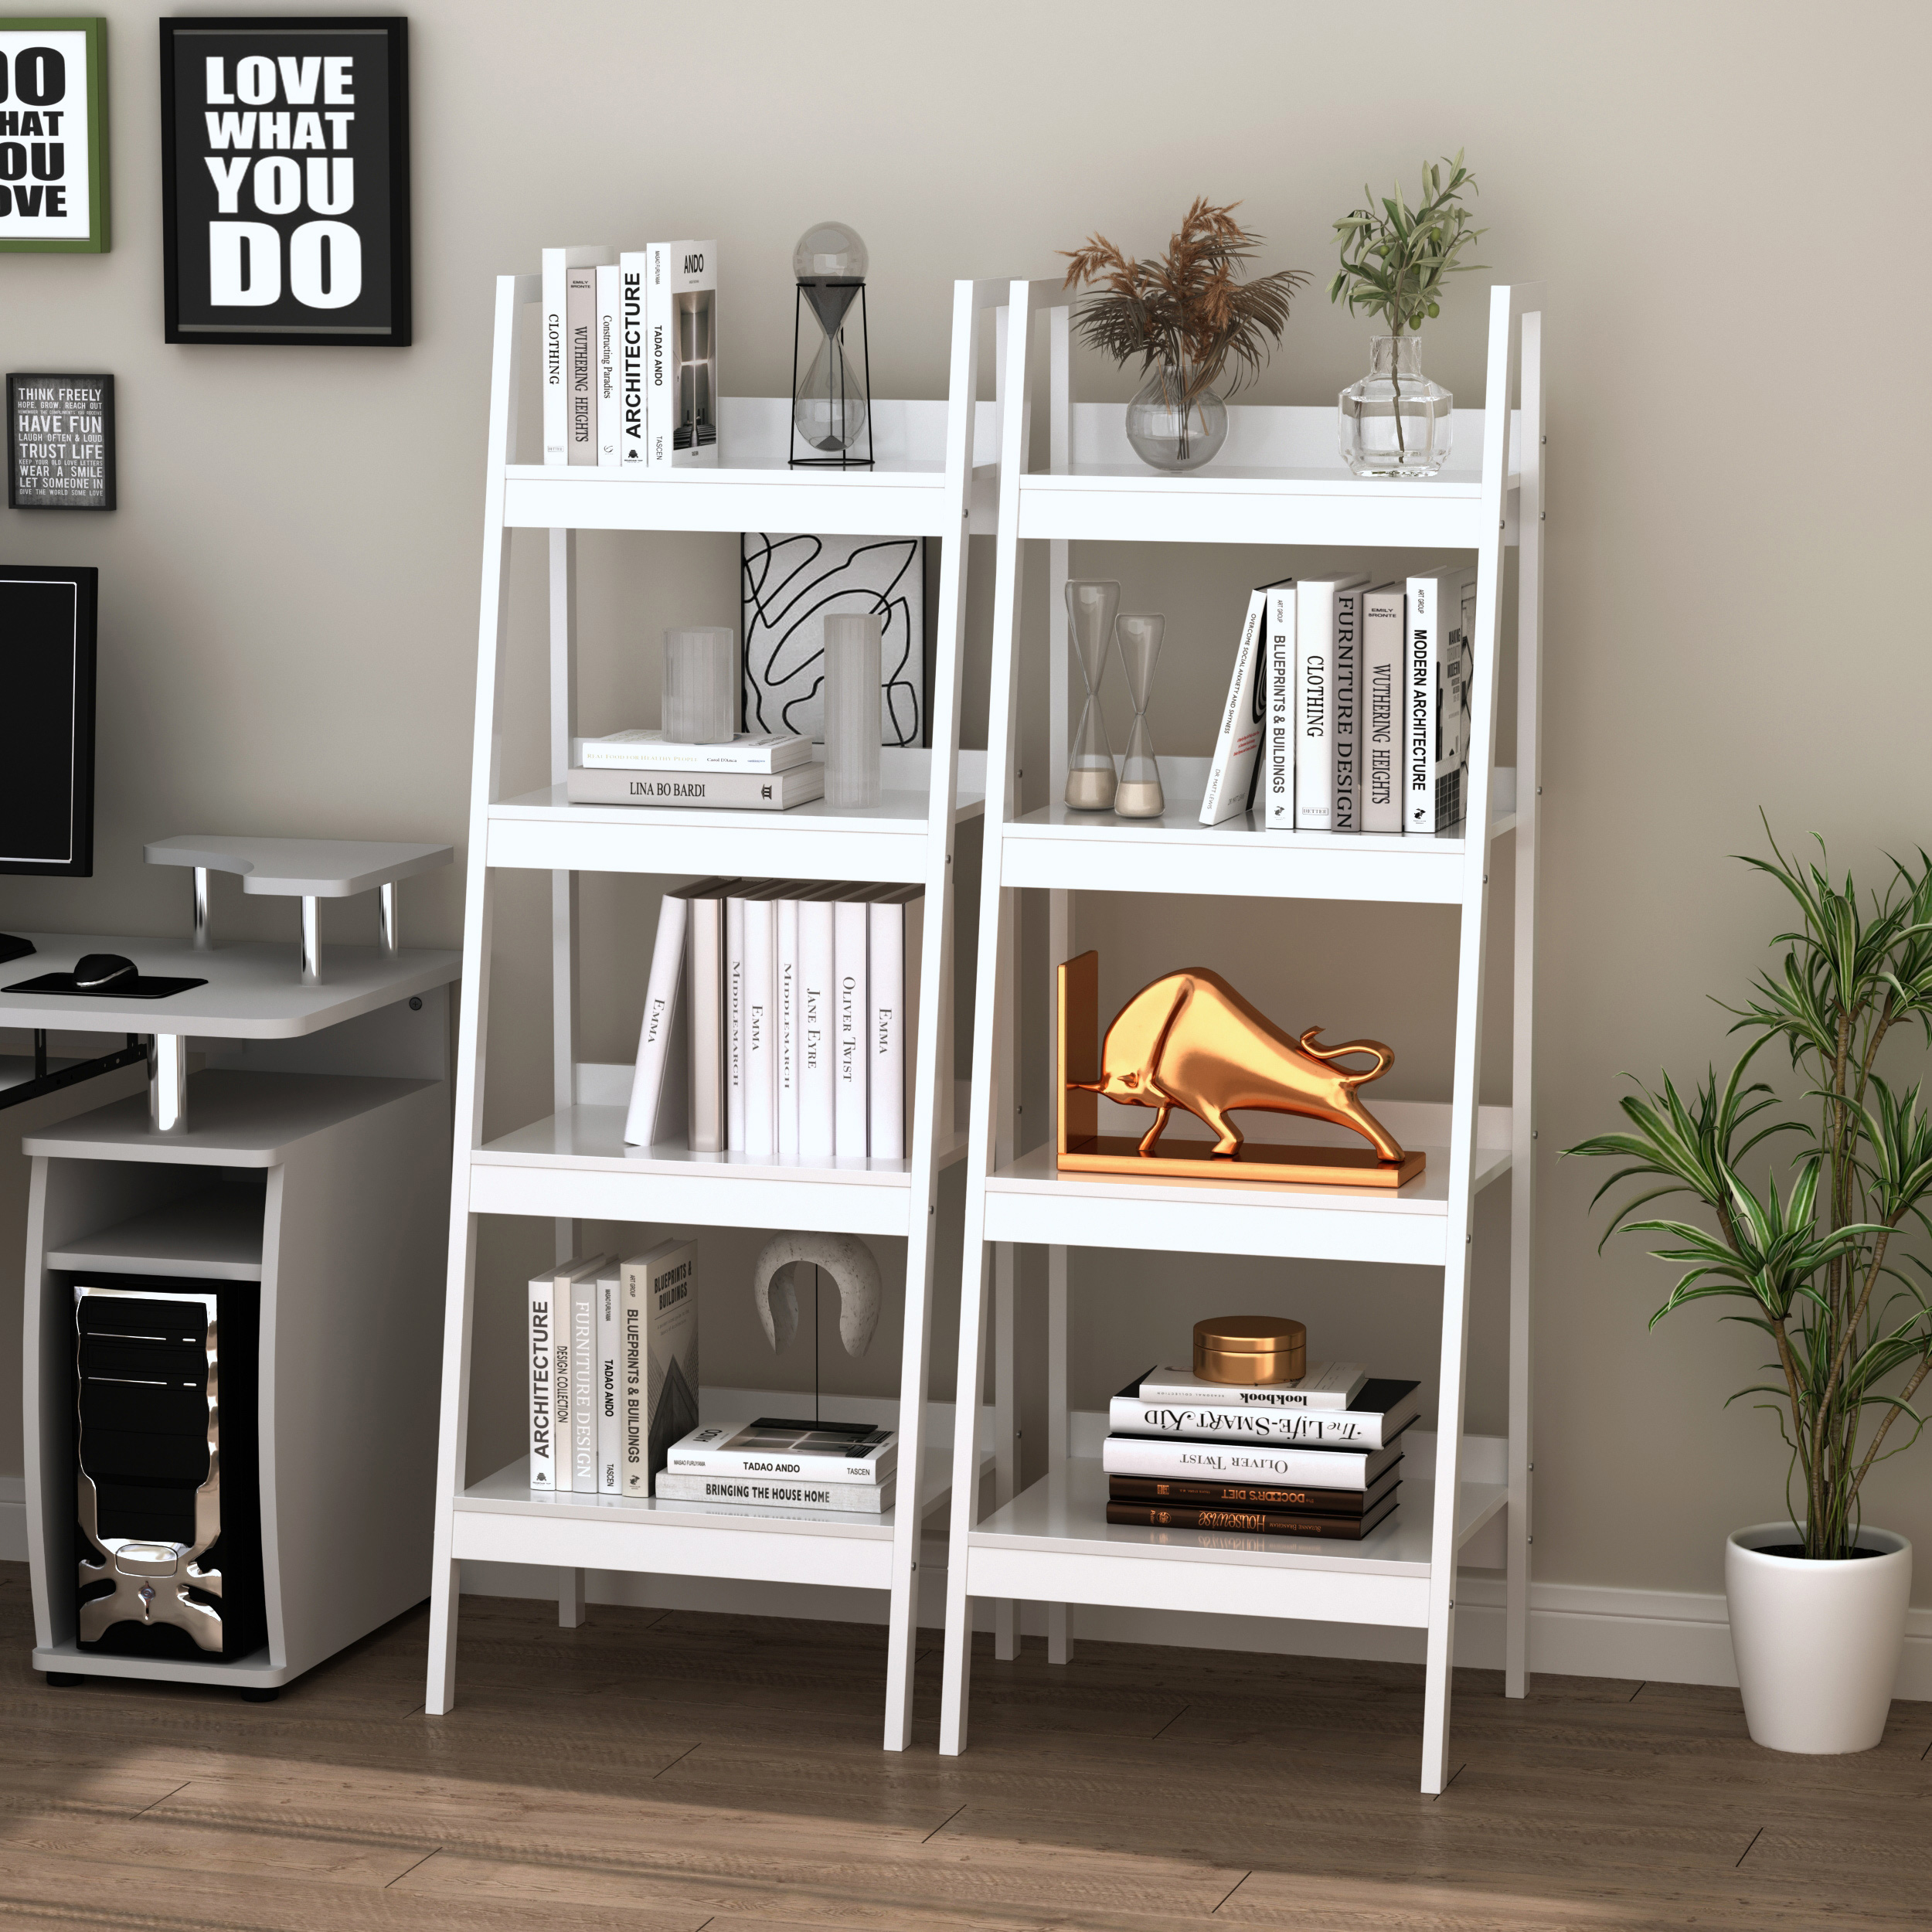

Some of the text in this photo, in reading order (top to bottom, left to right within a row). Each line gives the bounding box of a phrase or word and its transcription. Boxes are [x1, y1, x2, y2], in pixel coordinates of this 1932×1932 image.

[0, 46, 66, 106] O
[206, 56, 355, 105] LOVE
[0, 111, 64, 136] HAT
[205, 111, 355, 149] WHAT
[0, 141, 65, 181] OU
[0, 185, 67, 217] VE
[204, 156, 354, 215] YOU
[209, 220, 362, 308] DO
[684, 253, 703, 274] ANDO
[549, 314, 560, 385] CLOTHING
[601, 315, 613, 399] Constructing Paradies
[625, 273, 641, 438] ARCHITECTURE
[19, 388, 101, 401] THINK FREELY
[574, 326, 588, 442] WUTHERING HEIGHTS
[19, 415, 101, 433] HAVE FUN
[19, 444, 103, 459] TRUST LIFE
[20, 465, 102, 477] WEAR A SMILE
[20, 478, 103, 488] LET SOMEONE IN
[1244, 614, 1257, 645] OVERCOME
[1239, 647, 1249, 668] SOCIAL
[1235, 669, 1243, 695] ANXIETY
[1307, 655, 1324, 737] CLOTHING
[1224, 709, 1234, 734] SHYNESS
[1273, 635, 1285, 794] BLUEPRINTS & BUILDINGS
[1337, 597, 1354, 828] FURNITURE DESIGN
[1413, 630, 1427, 791] MODERN ARCHITECTURE
[1372, 664, 1391, 804] WUTHERING HEIGHTS
[630, 782, 706, 798] LINA BO BARDI
[648, 998, 665, 1043] EMMA
[752, 1005, 763, 1051] EMMA
[807, 988, 821, 1069] JANE EYRE
[842, 977, 855, 1082] OLIVER TWIST
[879, 1008, 892, 1055] EMMA
[655, 1260, 692, 1294] BLUEPRINTS &
[659, 1281, 687, 1311] BUILDINGS
[532, 1301, 549, 1459] ARCHITECTURE
[556, 1345, 568, 1423] DESIGN COLLECTION
[576, 1301, 590, 1478] FURNITURE DESIGN
[604, 1359, 614, 1417] TADAO ANDO
[627, 1309, 640, 1463] BLUEPRINTS & BUILDINGS
[1240, 1392, 1308, 1406] lookbook
[693, 1429, 723, 1443] ANDO
[743, 1462, 800, 1473] TADAO ANDO
[1180, 1454, 1288, 1474] OLIVER TWIST
[706, 1484, 830, 1502] BRINGING THE HOUSE HOME
[1221, 1489, 1247, 1499] DIET
[1198, 1511, 1266, 1532] Housewise
